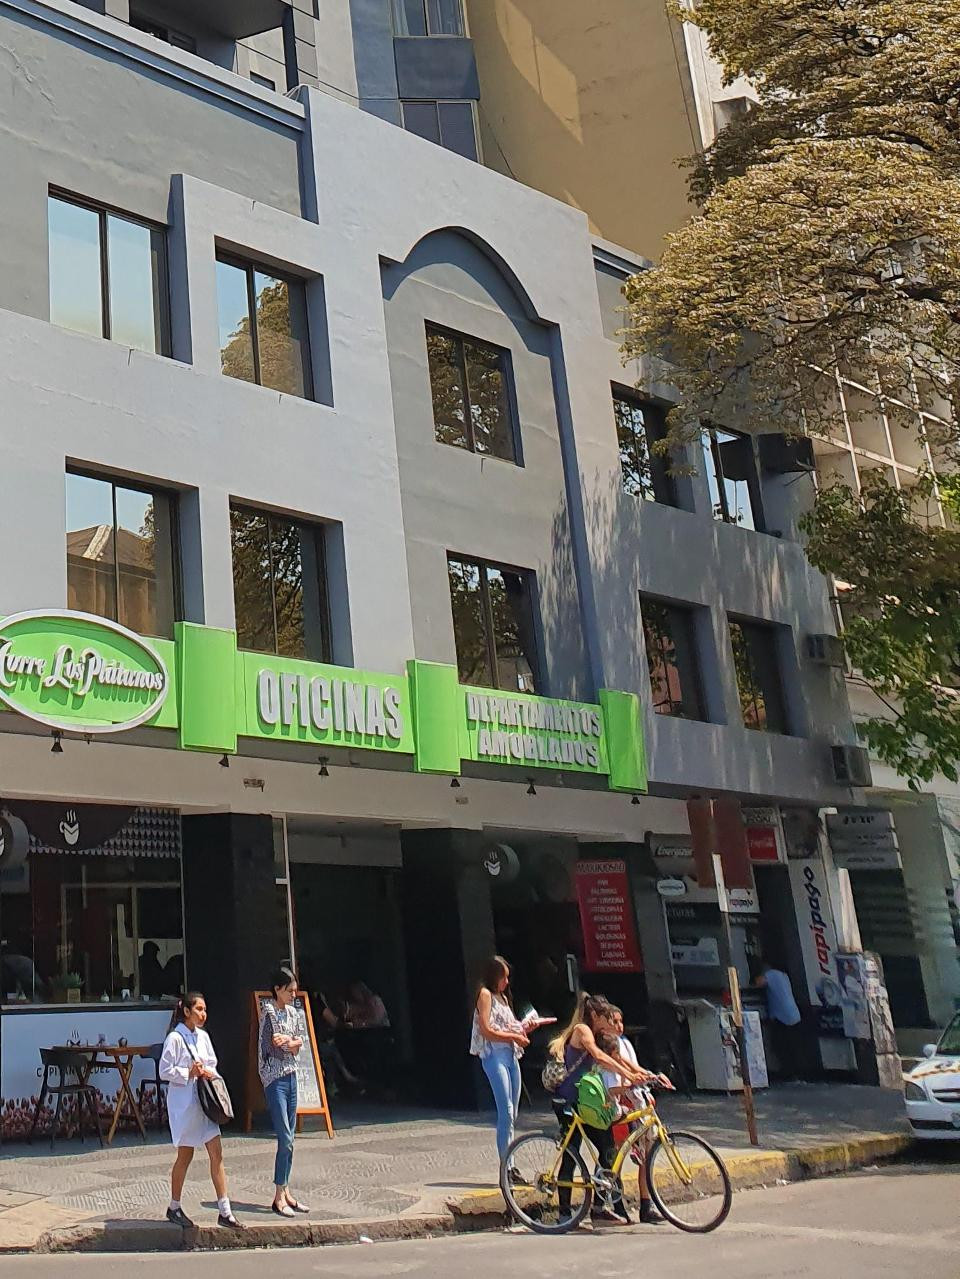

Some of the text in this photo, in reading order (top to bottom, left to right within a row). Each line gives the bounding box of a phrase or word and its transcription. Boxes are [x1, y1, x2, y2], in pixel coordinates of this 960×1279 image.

[42, 644, 84, 689] Los
[256, 668, 402, 739] OFICINAS
[466, 692, 602, 738] DEPARTAMENTOS
[478, 730, 599, 768] AMOBLADOS
[803, 865, 832, 976] rapipago
